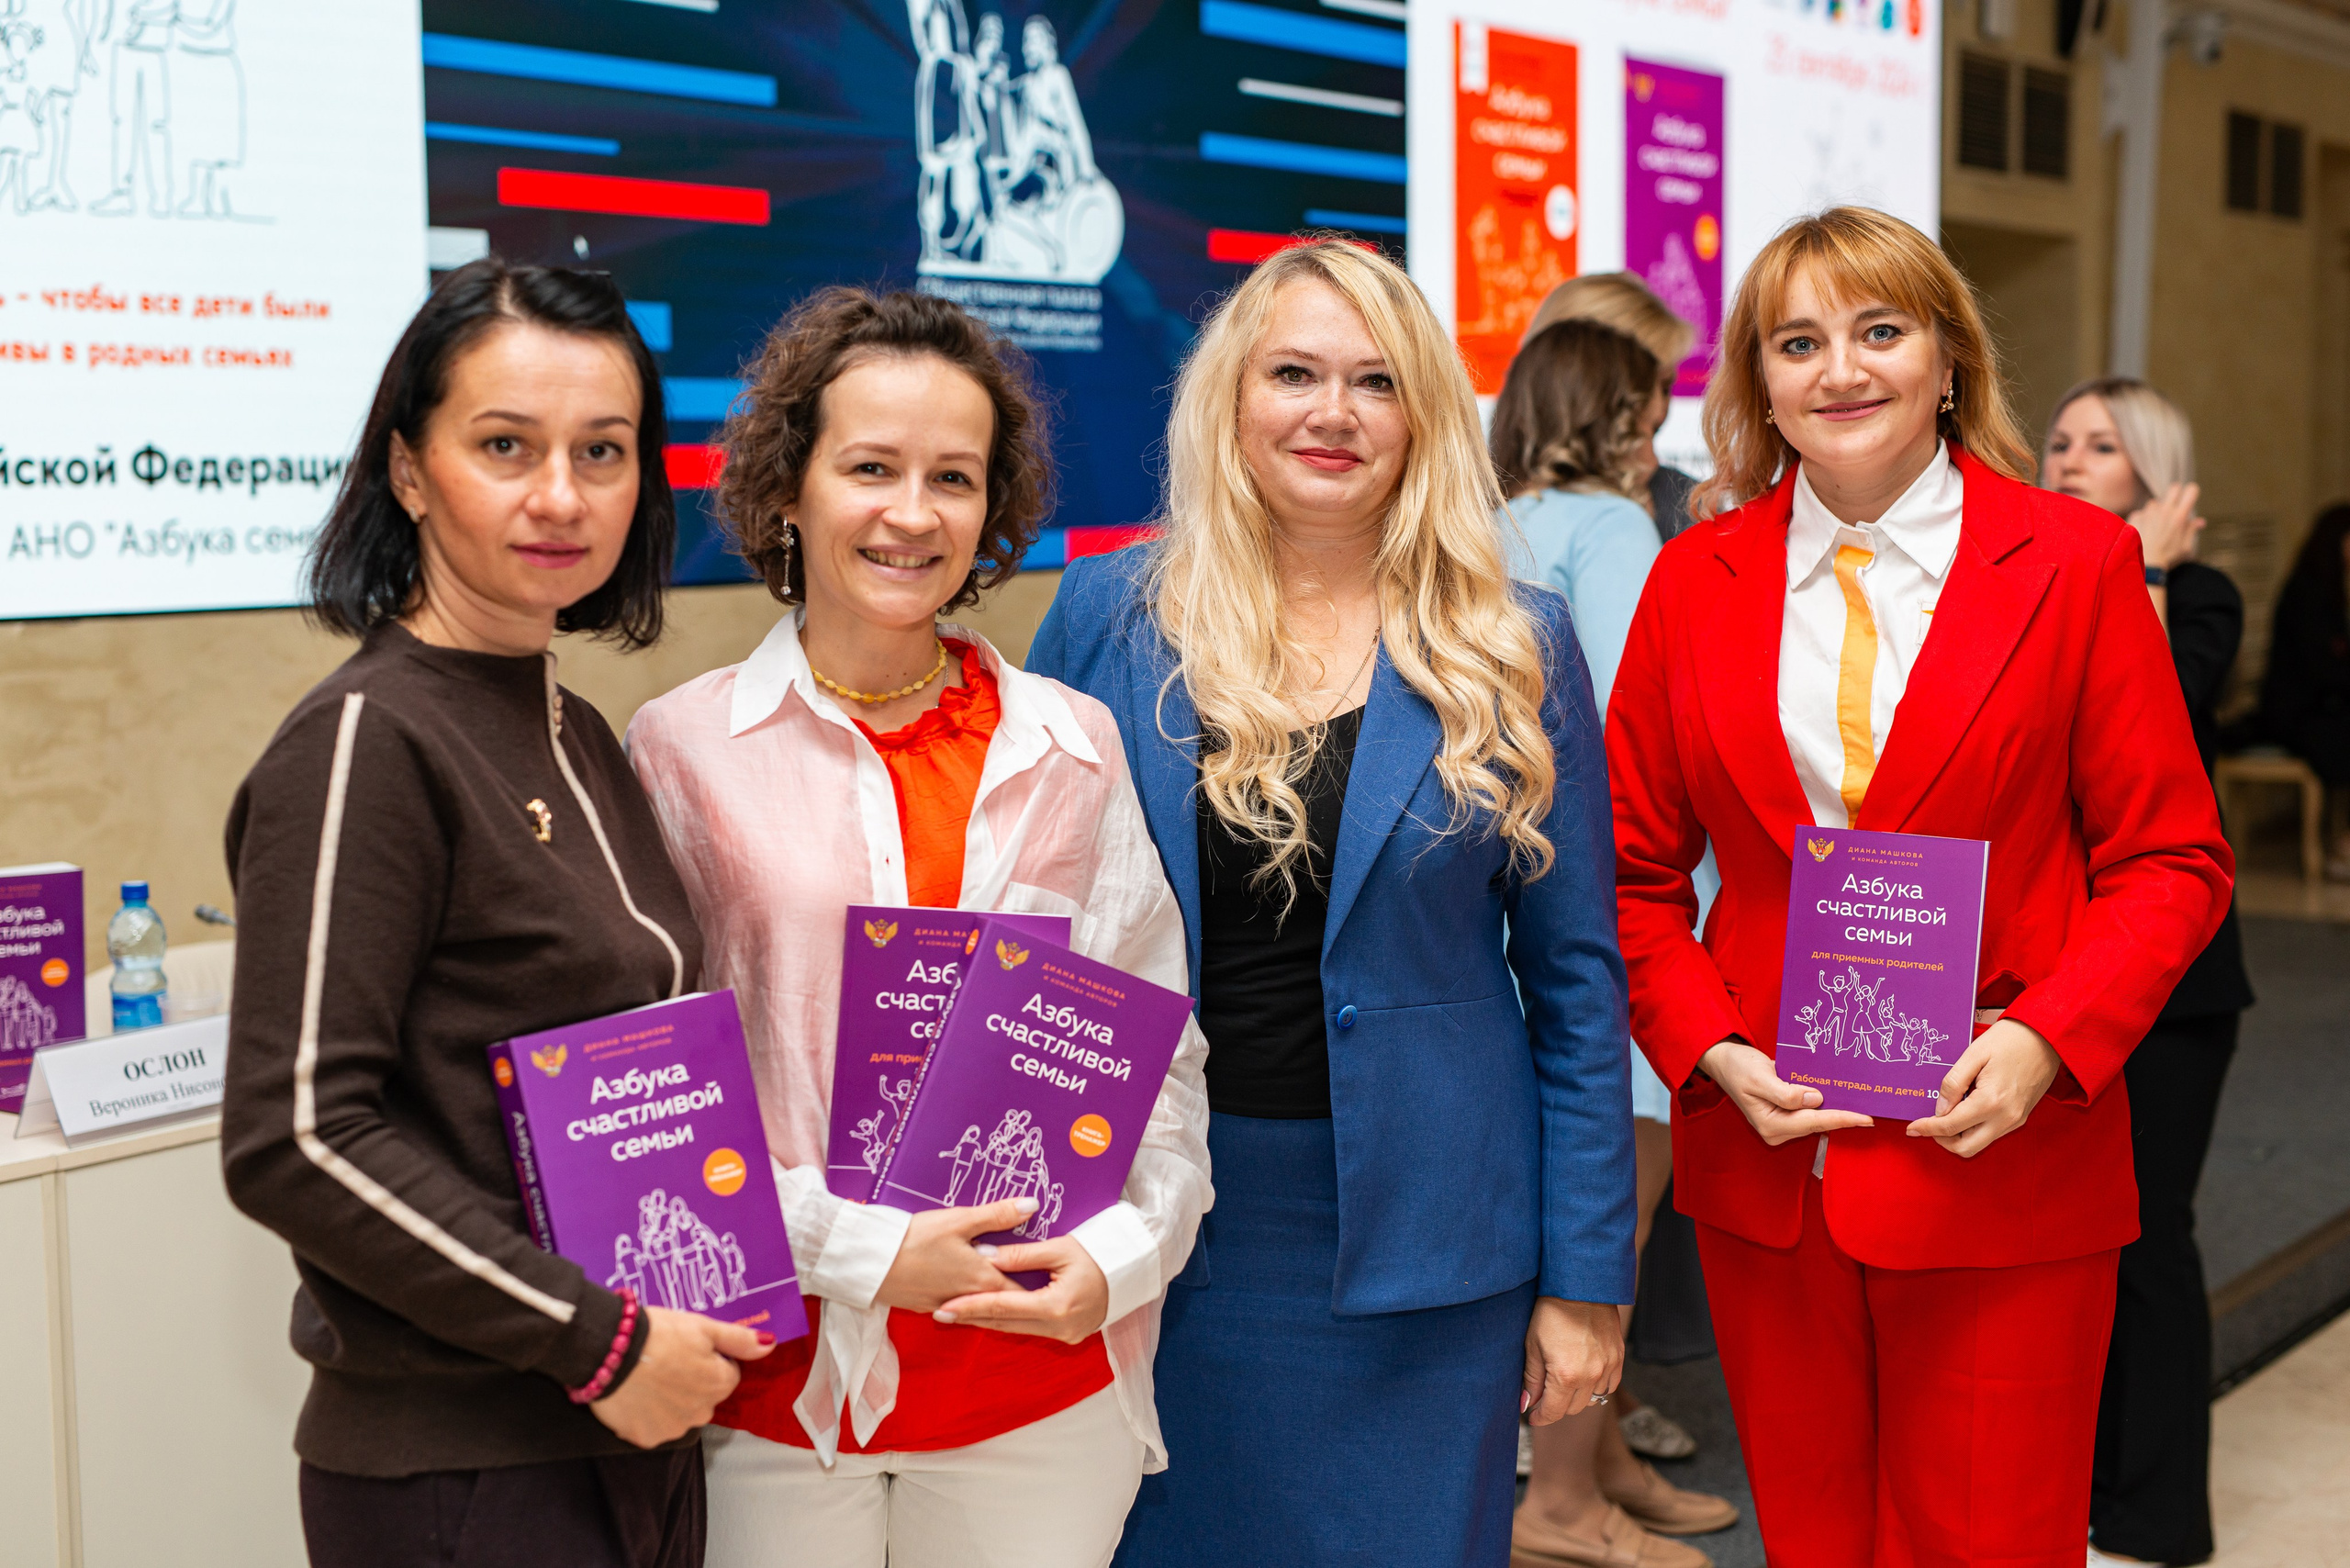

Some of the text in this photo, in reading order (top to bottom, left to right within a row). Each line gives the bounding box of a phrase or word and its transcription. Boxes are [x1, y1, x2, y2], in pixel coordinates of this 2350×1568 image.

[141, 293, 181, 312] все
[194, 295, 253, 319] дети
[8, 521, 95, 558] АНО
[1848, 846, 1923, 858] ДИАНА МАШКОВА
[1841, 873, 1923, 901] Азбука
[1817, 898, 1946, 926] счастливой
[1844, 925, 1913, 946] семьи
[1811, 951, 1944, 971] для приемных родителей
[1042, 962, 1125, 1000] ДИАНА МАШКОВА
[1022, 993, 1113, 1047] Азбука
[869, 1053, 893, 1063] для
[986, 1013, 1132, 1082] счастливой
[124, 1047, 207, 1081] ОСЛОН
[1010, 1052, 1087, 1095] семьи
[590, 1063, 690, 1104] Азбука
[1790, 1072, 1940, 1099] Рабочая тетрадь для детей 10
[89, 1090, 169, 1118] Вероника
[566, 1081, 723, 1142] счастливой
[610, 1124, 694, 1161] семьи
